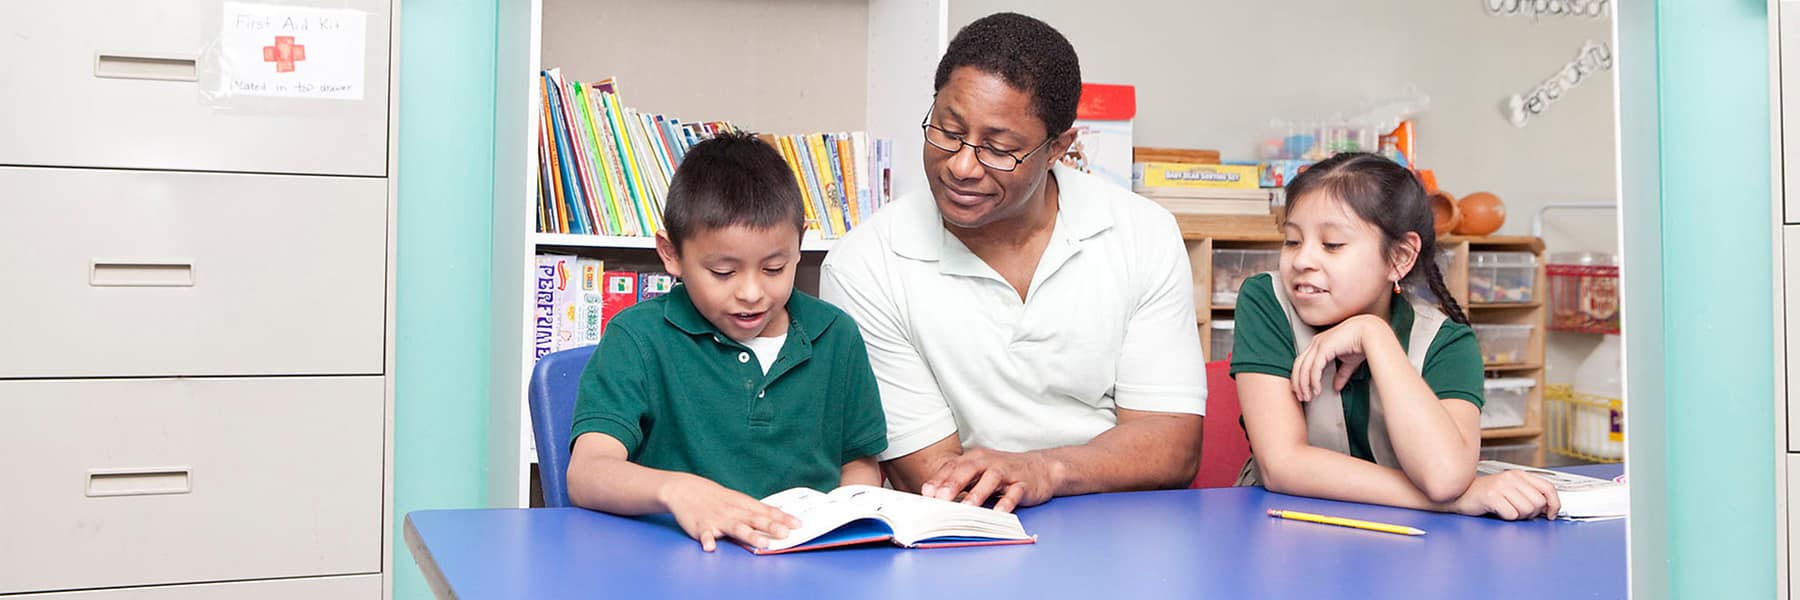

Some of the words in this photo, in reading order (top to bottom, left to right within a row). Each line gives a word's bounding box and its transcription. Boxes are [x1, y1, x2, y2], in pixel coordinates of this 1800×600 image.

[235, 13, 271, 31] First
[282, 16, 309, 31] Aid
[319, 17, 341, 31] Kit
[276, 83, 287, 91] in
[535, 264, 556, 363] PERFUME
